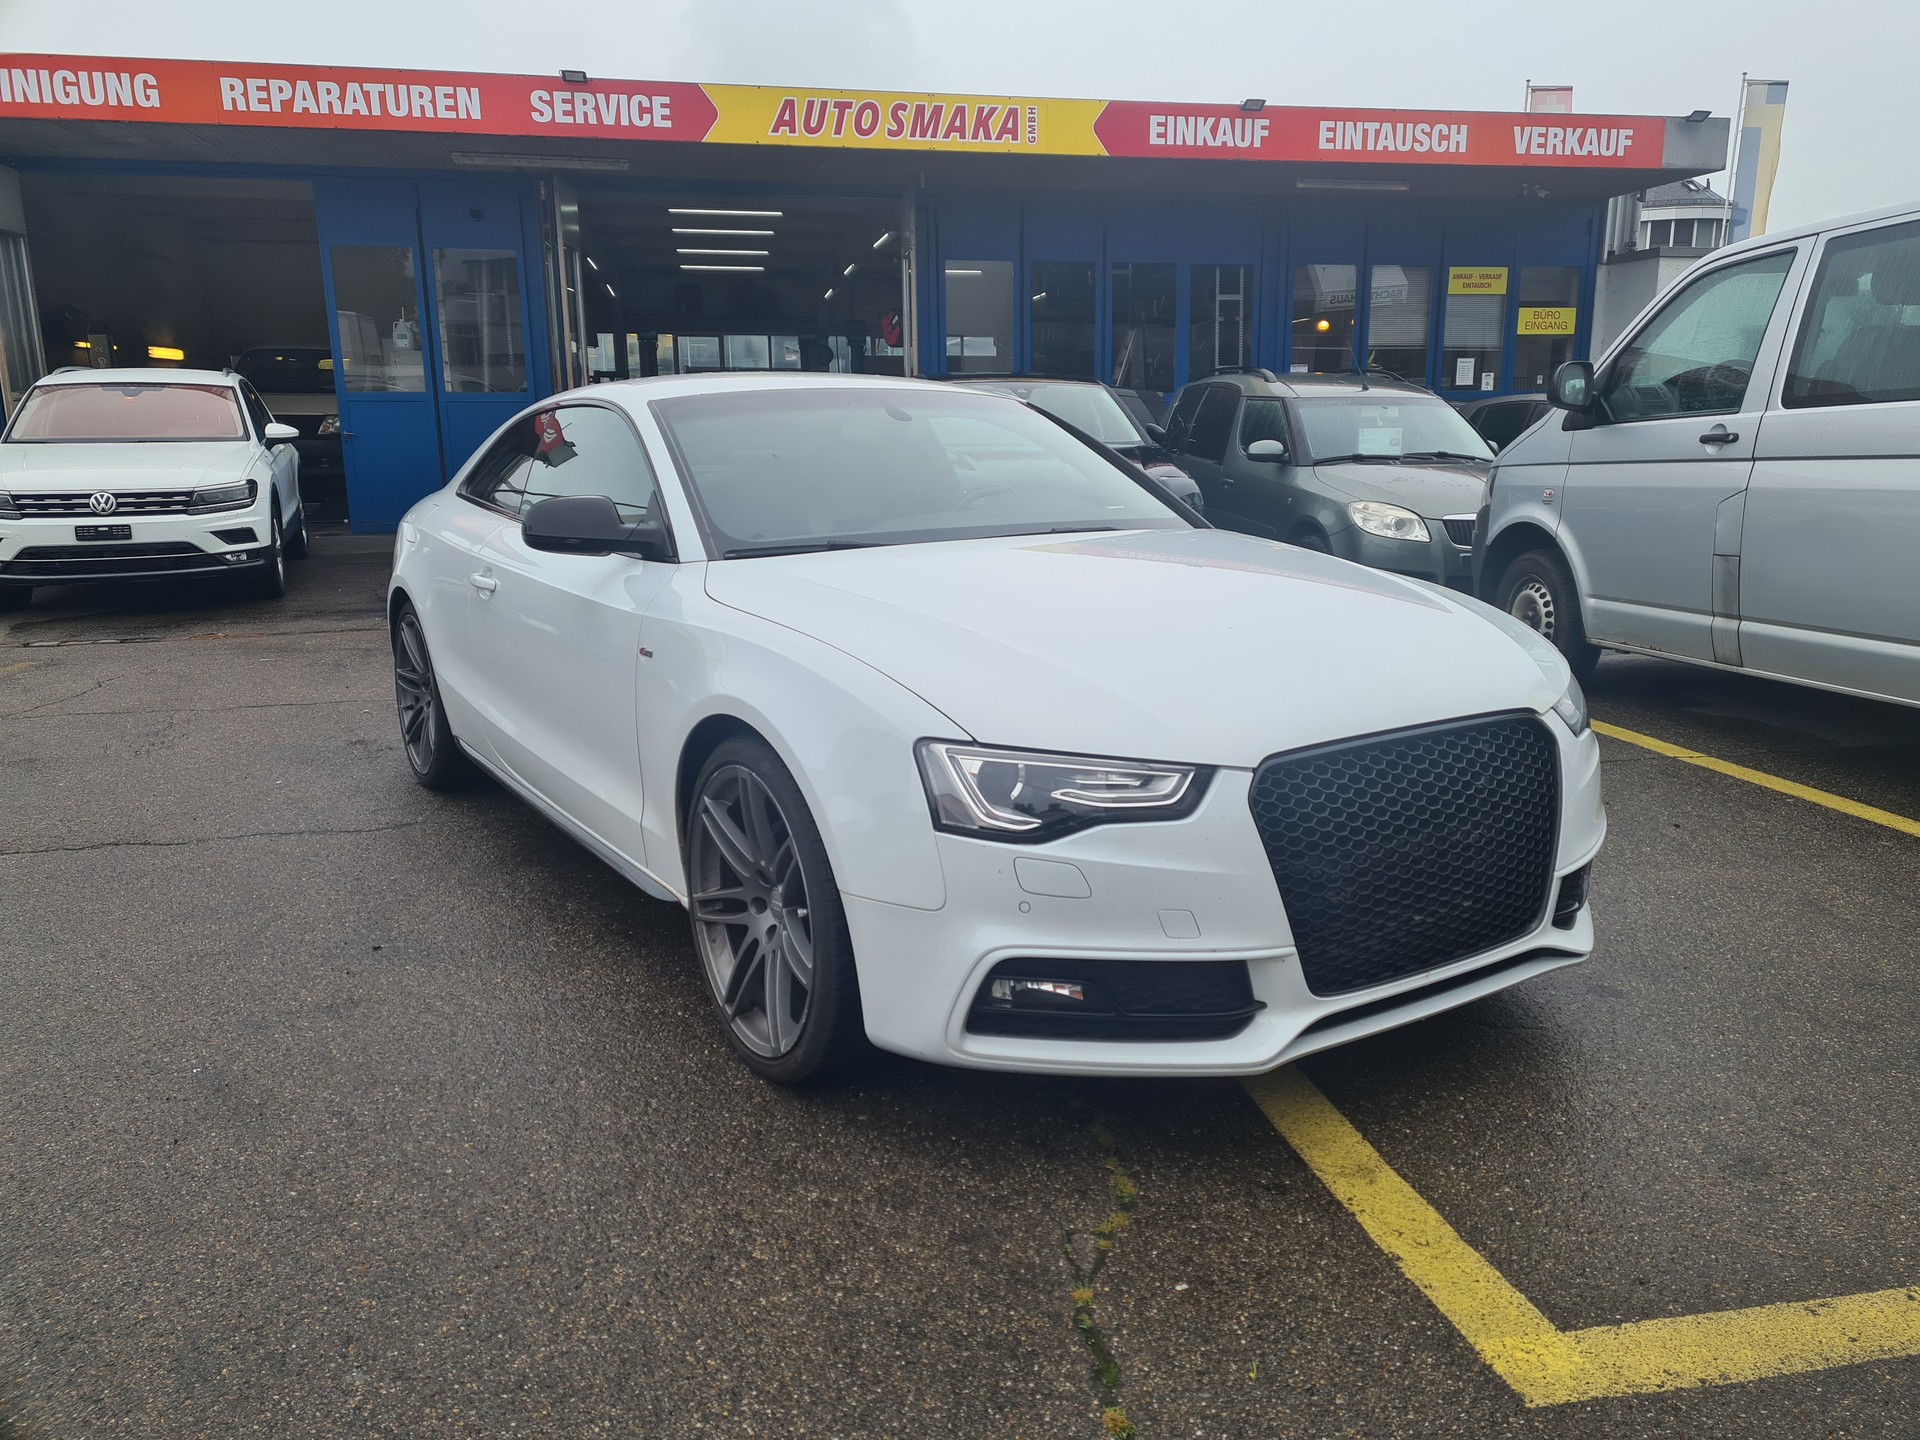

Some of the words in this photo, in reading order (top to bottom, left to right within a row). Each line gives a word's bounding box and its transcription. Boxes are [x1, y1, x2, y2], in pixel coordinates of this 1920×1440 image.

[0, 68, 160, 108] INIGUNG
[219, 77, 482, 120] REPARATUREN
[529, 89, 673, 128] SERVICE
[768, 97, 881, 138] AUTO
[885, 100, 1021, 144] SMAKA
[1026, 105, 1038, 145] GMBH
[1149, 115, 1270, 148] EINKAUF
[1318, 120, 1468, 153] EINTAUSCH
[1513, 126, 1634, 157] VERKAUF
[1524, 321, 1568, 331] EINGANG
[1533, 309, 1561, 320] BÜRO
